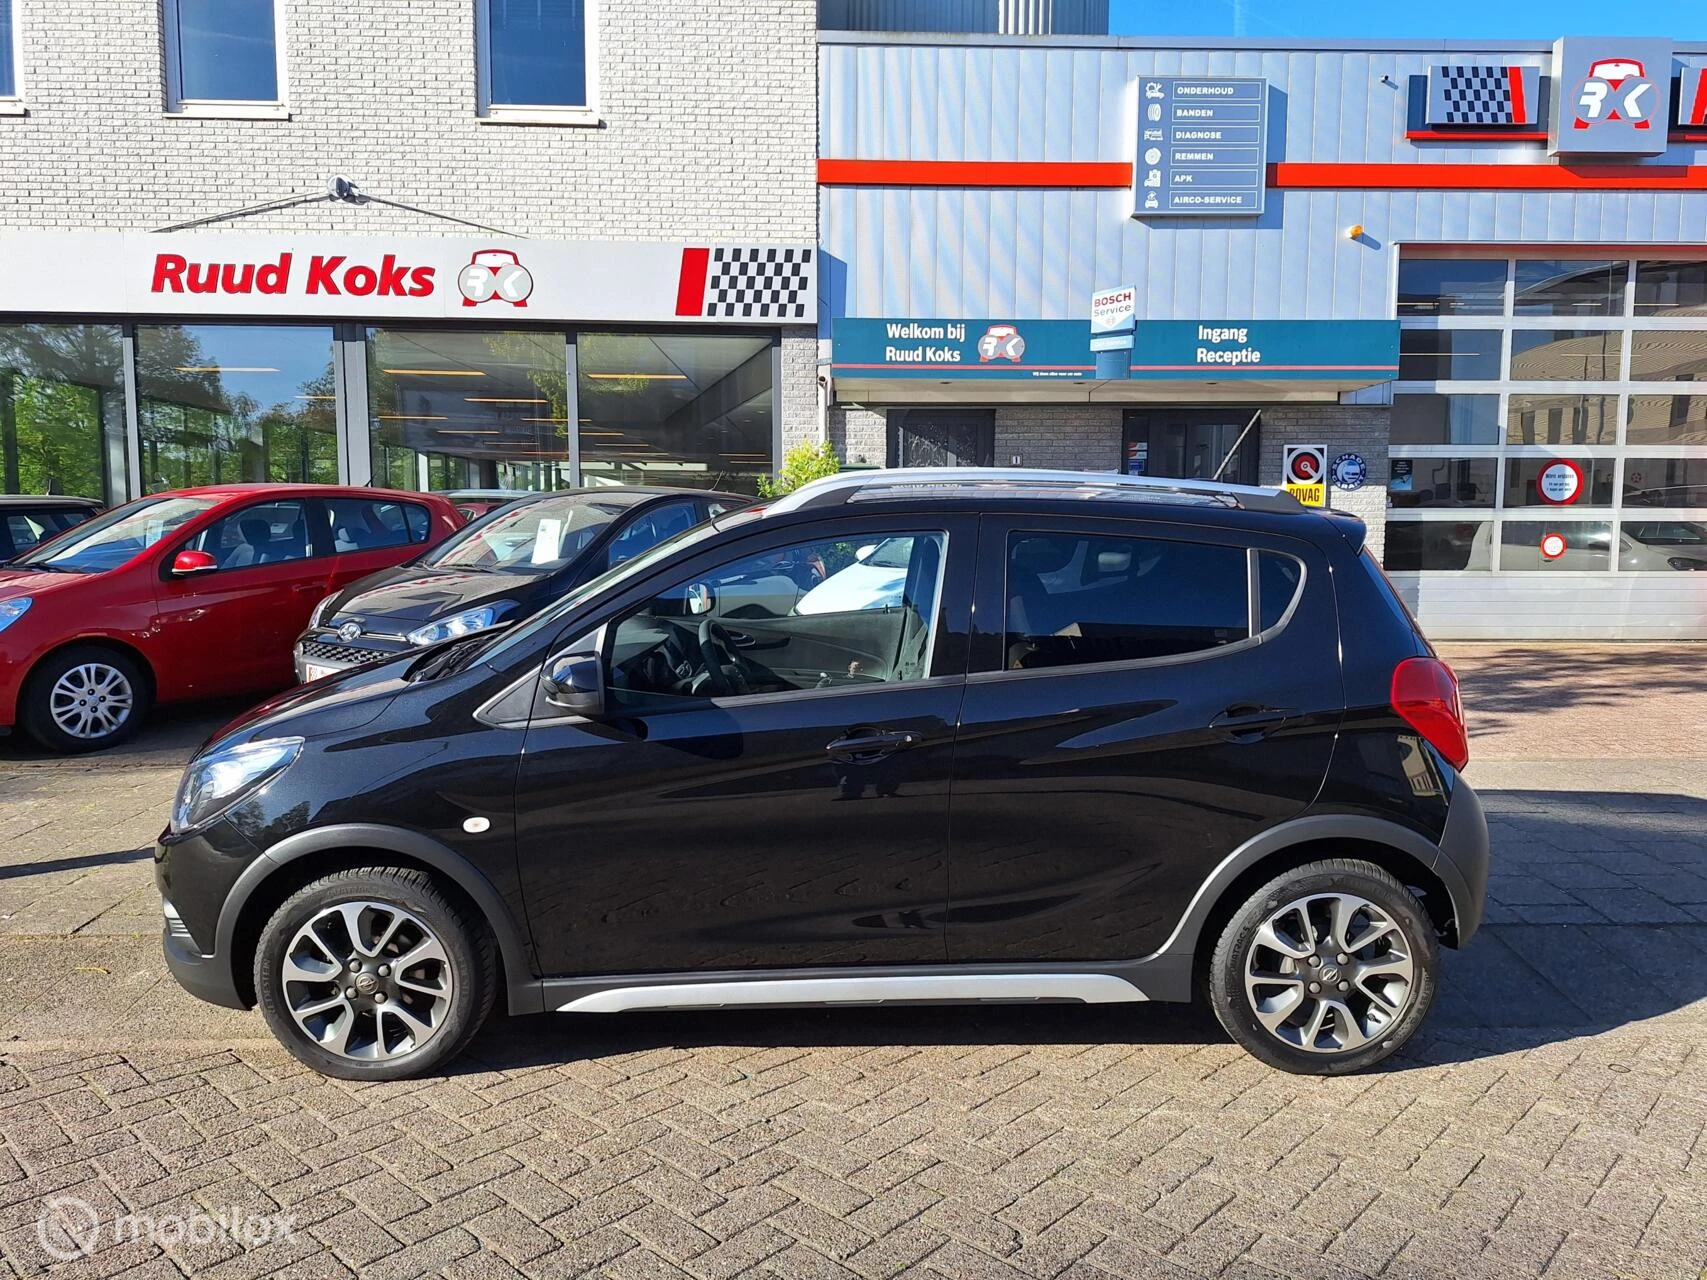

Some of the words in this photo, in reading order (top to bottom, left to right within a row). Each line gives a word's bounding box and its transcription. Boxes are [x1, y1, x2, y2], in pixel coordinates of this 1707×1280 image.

[1177, 87, 1234, 95] ONDERHOUD
[1176, 109, 1214, 117] BANDEN
[1175, 131, 1222, 139] DIAGNOSE
[1175, 152, 1214, 161] REMMEN
[1174, 174, 1193, 182] APK
[1173, 196, 1243, 204] AIRCO-SERVICE
[151, 252, 293, 295] Ruud
[305, 254, 436, 297] Koks
[1094, 291, 1132, 307] BOSCH
[1094, 304, 1132, 317] Service
[886, 323, 944, 339] Welkom
[947, 323, 966, 342] bij
[1198, 324, 1248, 343] Ingang
[885, 346, 922, 362] Ruud
[926, 346, 961, 362] Koks
[1196, 347, 1261, 366] Receptie
[1331, 454, 1366, 470] SCHADE
[1331, 475, 1364, 489] GARANT
